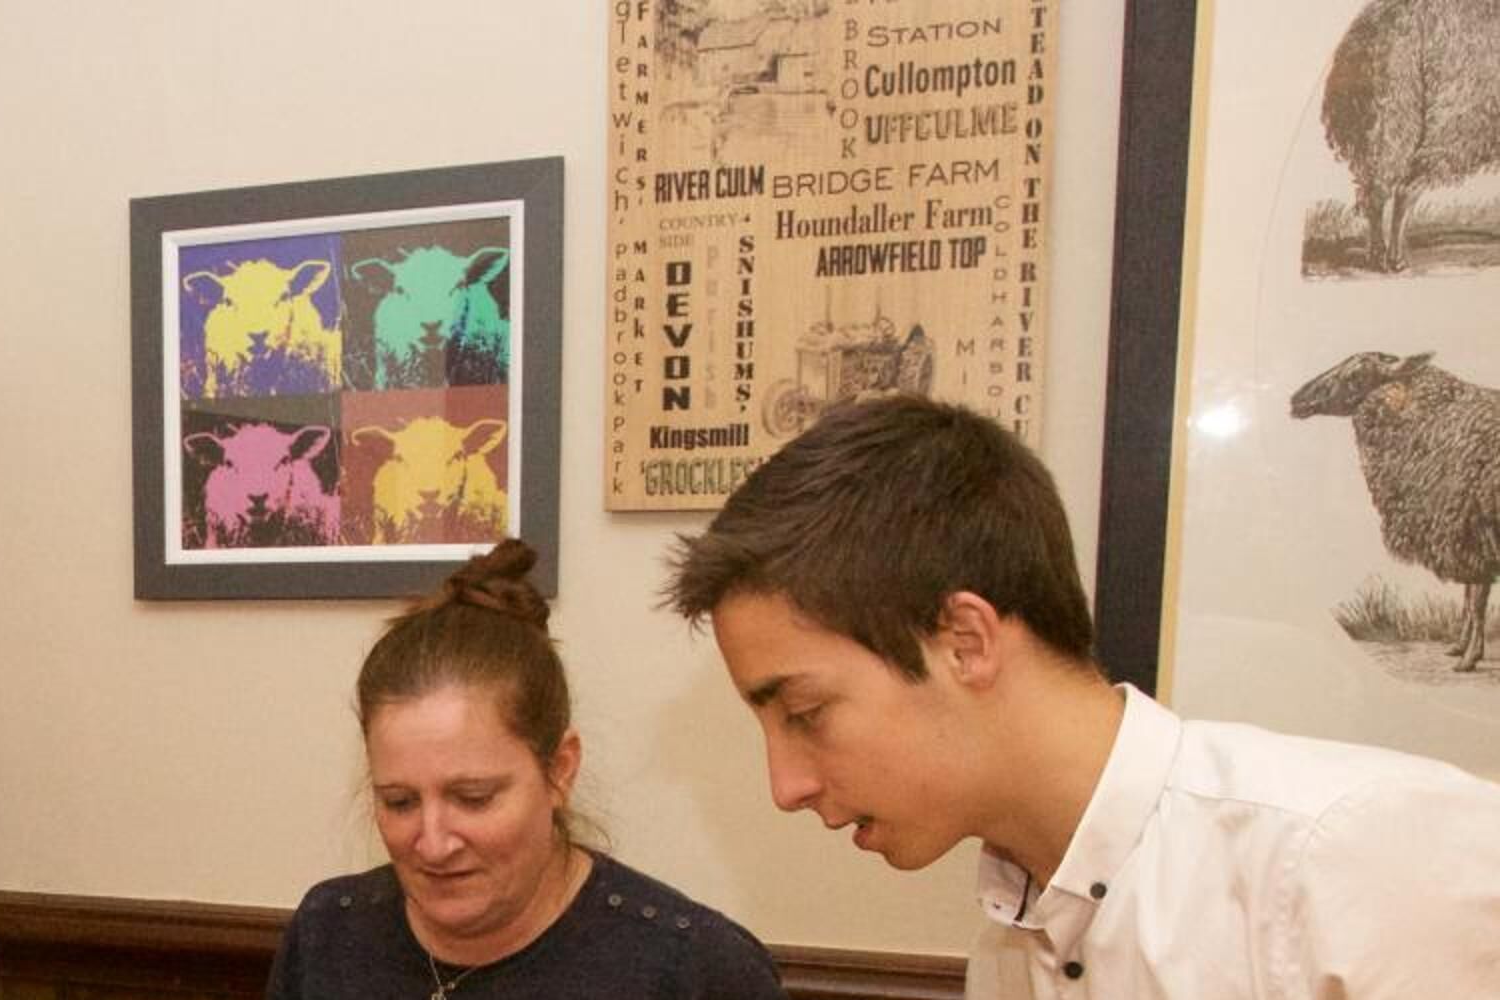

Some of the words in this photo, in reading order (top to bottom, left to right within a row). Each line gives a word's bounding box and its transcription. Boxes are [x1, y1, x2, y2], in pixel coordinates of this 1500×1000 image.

[866, 18, 1004, 48] STATION
[1026, 0, 1048, 105] TEAD
[840, 18, 859, 159] BROOK
[864, 57, 1017, 98] Cullompton
[865, 101, 1019, 145] UFFCULME
[1024, 118, 1044, 165] ON
[654, 169, 711, 205] RIVER
[715, 164, 765, 199] CULM
[772, 166, 894, 199] BRIDGE
[908, 158, 1001, 188] FARM
[775, 202, 916, 241] Houndaller
[925, 198, 994, 230] Farm
[1021, 177, 1042, 248] THE
[815, 239, 943, 278] ARROWFIELD
[948, 236, 987, 269] TOP
[661, 259, 693, 412] DEVON
[1014, 262, 1038, 382] RIVER
[649, 424, 750, 451] Kingsmill
[1013, 394, 1032, 438] CU
